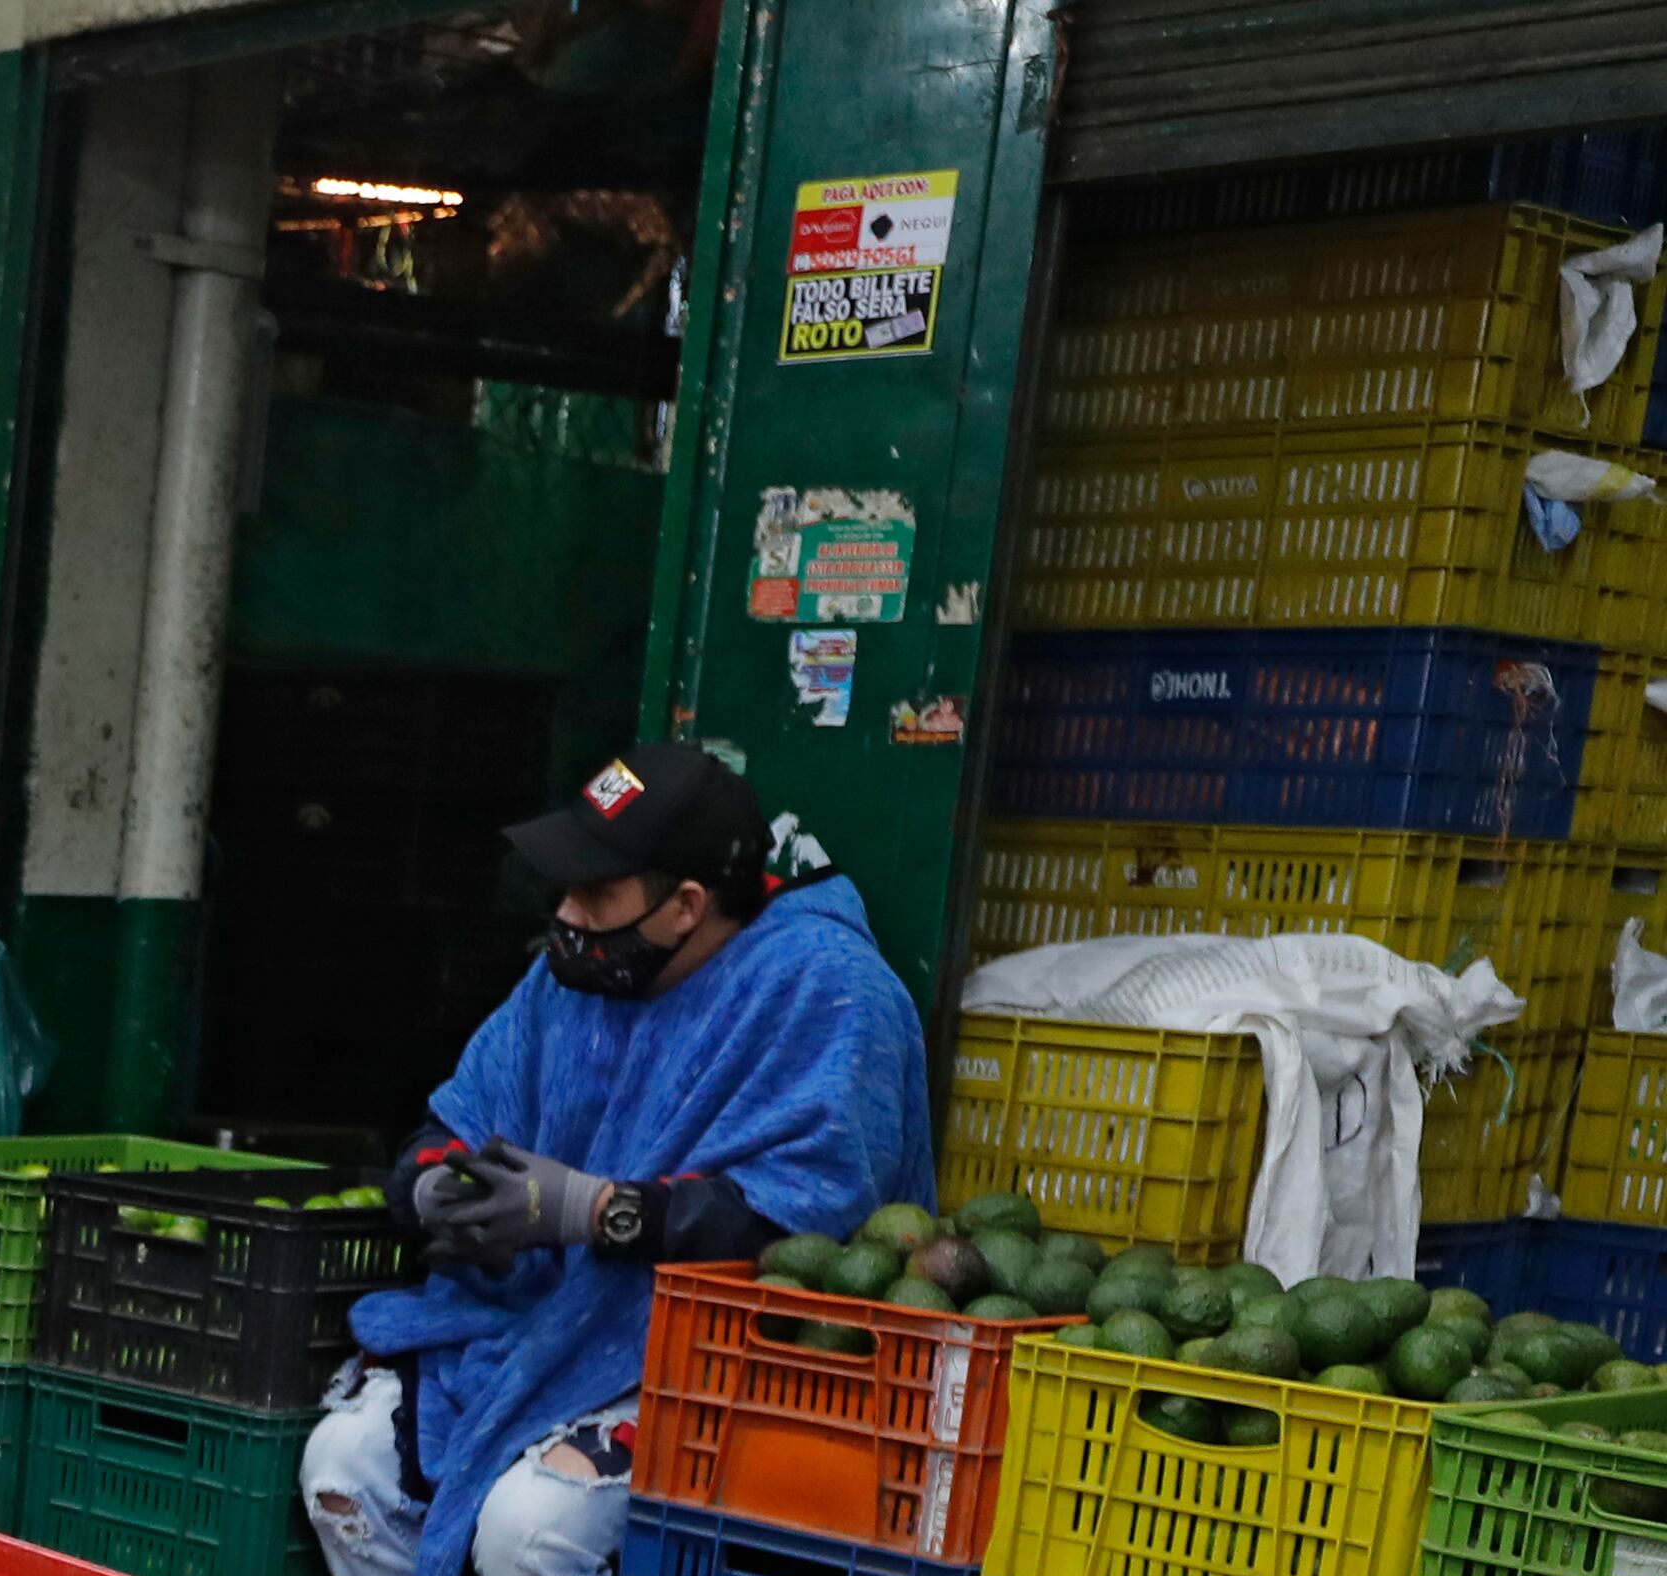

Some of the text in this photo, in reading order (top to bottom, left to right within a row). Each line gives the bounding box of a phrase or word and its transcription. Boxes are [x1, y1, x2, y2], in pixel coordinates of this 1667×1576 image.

[823, 184, 856, 202] PAGA
[901, 215, 948, 231] NEQUI
[794, 271, 933, 303] TODO BILLETE
[791, 295, 907, 325] FALSO SERA
[792, 318, 863, 351] ROTO
